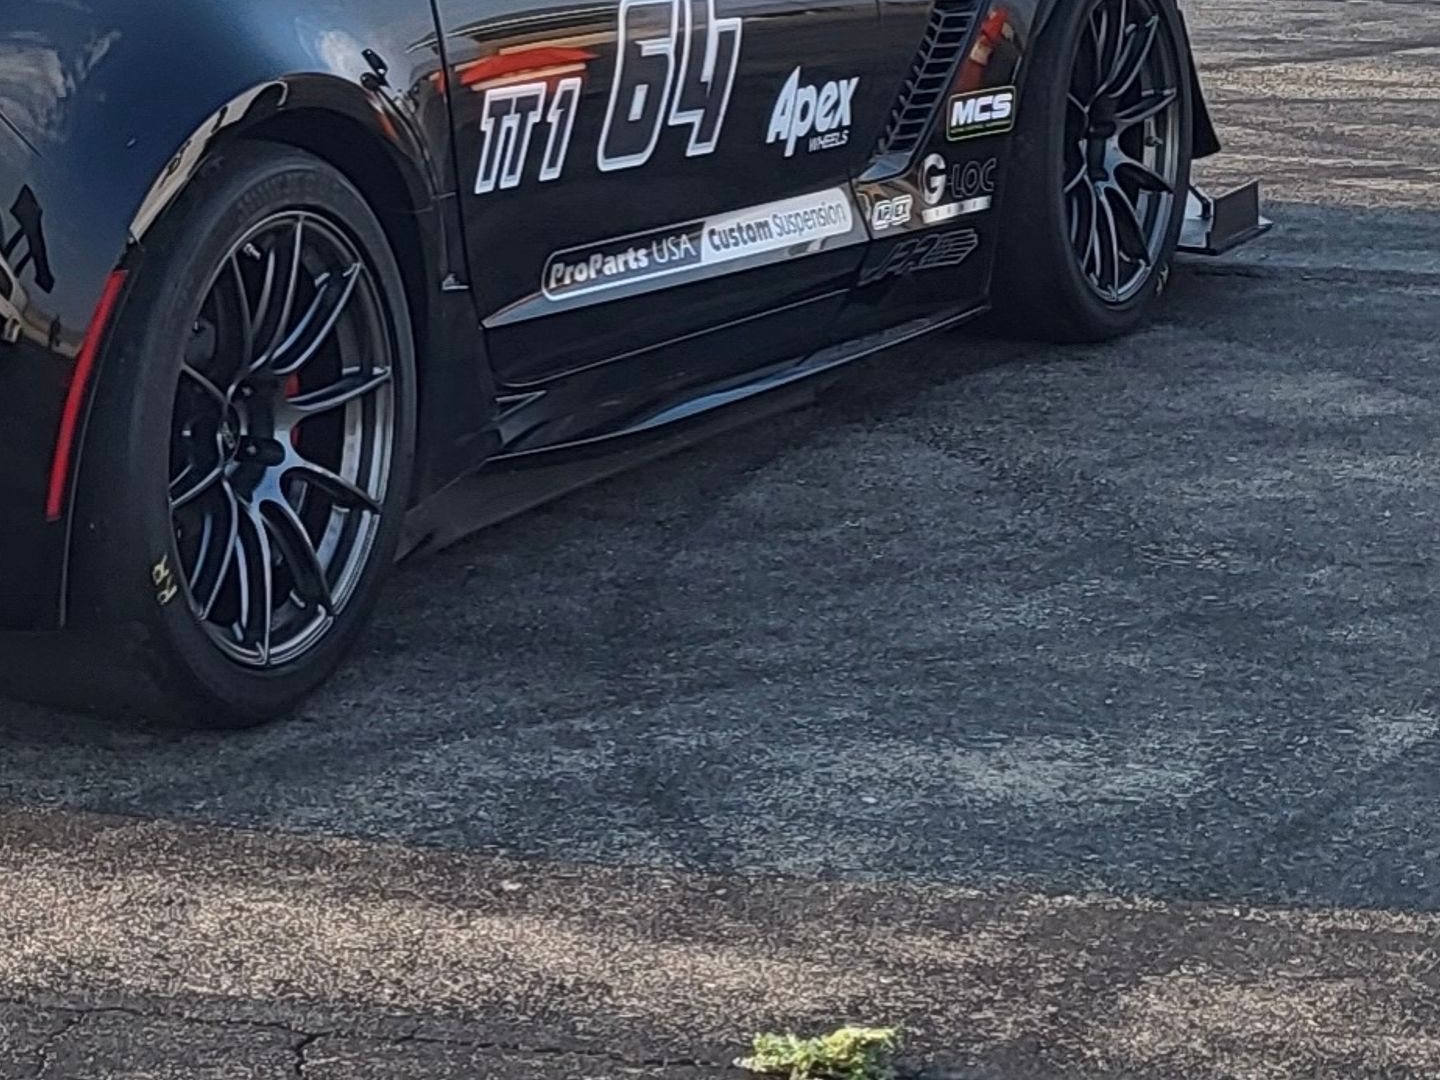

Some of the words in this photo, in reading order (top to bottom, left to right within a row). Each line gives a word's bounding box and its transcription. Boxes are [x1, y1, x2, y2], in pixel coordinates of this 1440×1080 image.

[475, 77, 581, 194] TT1
[766, 65, 859, 157] Apex
[950, 93, 1013, 127] MCS
[548, 246, 649, 289] ProParts
[652, 233, 697, 264] USA
[708, 218, 774, 252] Custom
[772, 201, 846, 238] Suspension
